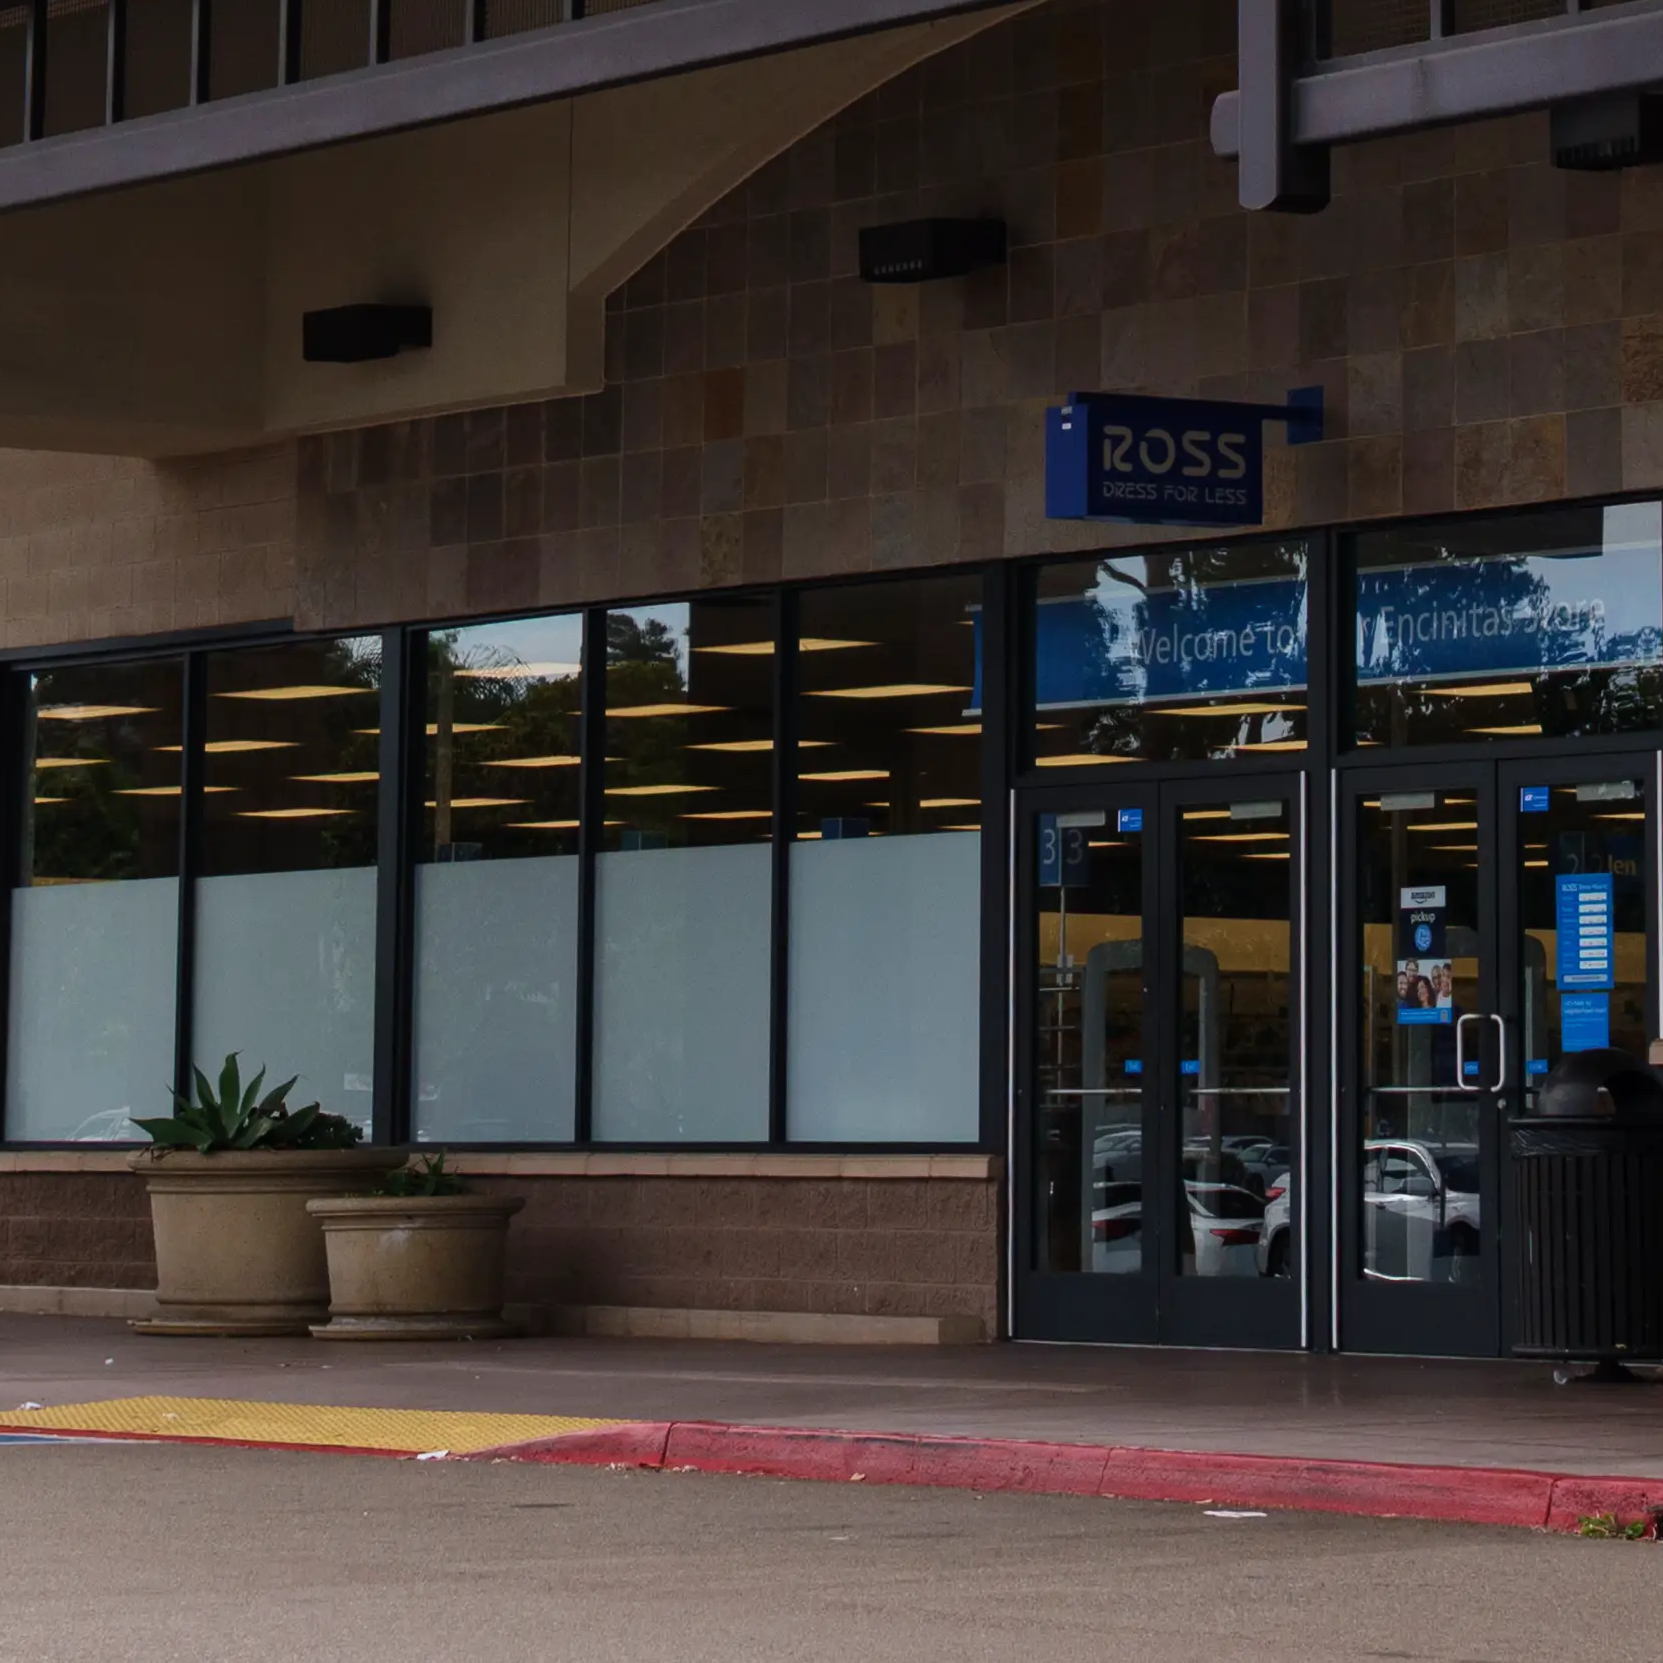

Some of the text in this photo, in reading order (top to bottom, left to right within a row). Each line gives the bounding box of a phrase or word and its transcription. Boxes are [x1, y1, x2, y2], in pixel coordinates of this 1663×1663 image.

[1102, 424, 1247, 479] ROSS
[1102, 481, 1248, 505] DRESS FOR LESS
[1130, 622, 1256, 665] Welcome
[1267, 622, 1295, 655] to
[1379, 601, 1513, 645] Encinitas
[1043, 828, 1056, 865] 3
[1410, 910, 1436, 925] pickup
